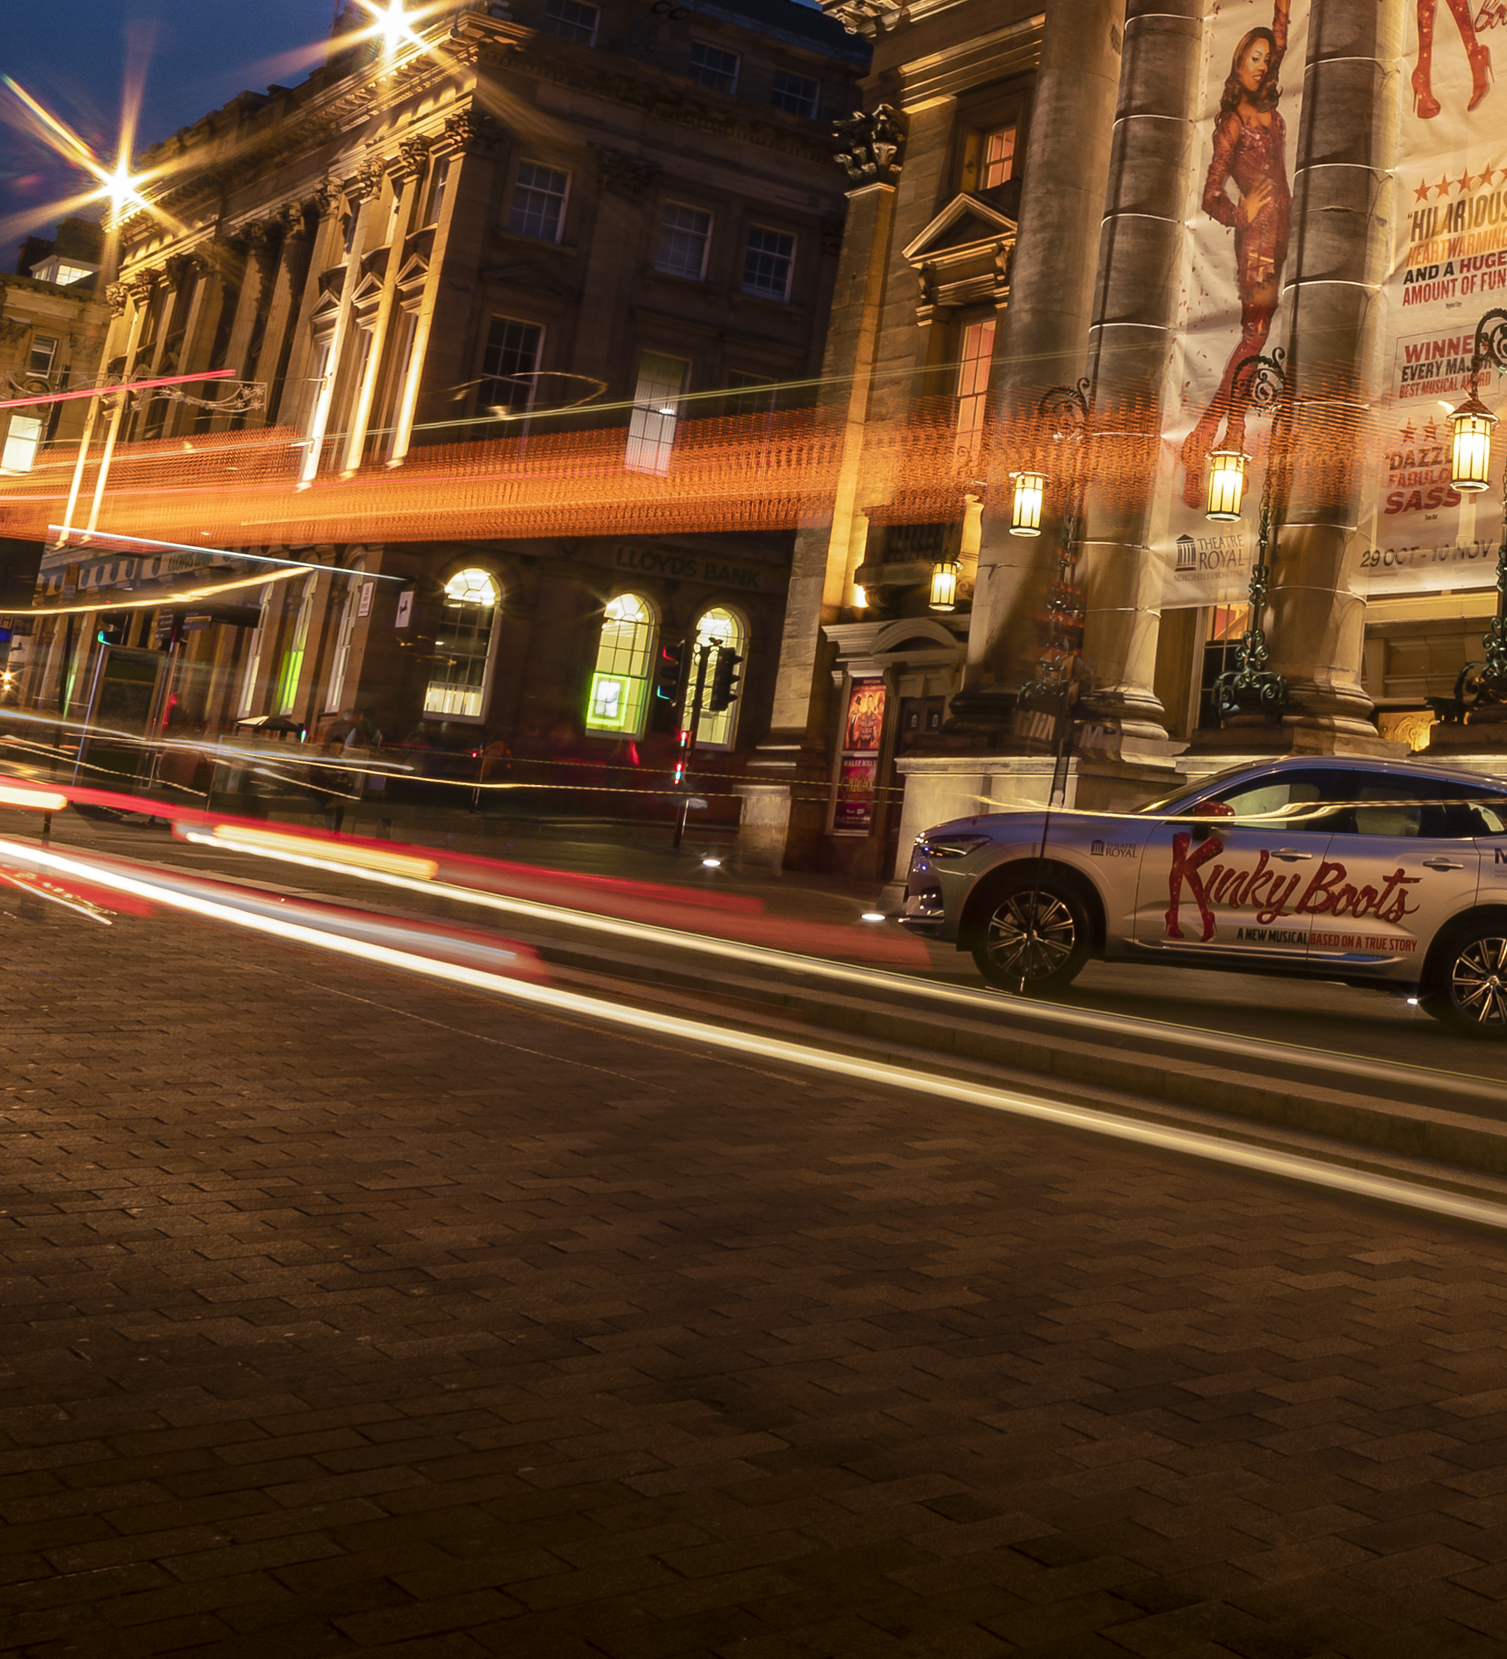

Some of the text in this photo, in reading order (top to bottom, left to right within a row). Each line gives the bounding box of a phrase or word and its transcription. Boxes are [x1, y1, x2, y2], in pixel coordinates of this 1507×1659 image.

[1403, 250, 1507, 285] AND A HUGE
[1402, 278, 1458, 306] AMOUNT
[1461, 274, 1477, 295] OF
[1401, 360, 1443, 382] EVERY
[1399, 382, 1421, 398] BEST
[1422, 377, 1458, 394] MUSICAL
[1197, 534, 1244, 551] THEATRE
[1360, 549, 1380, 567] 29
[1383, 546, 1419, 566] OCT
[1431, 544, 1449, 562] 10
[1452, 539, 1493, 560] NOV
[616, 547, 761, 588] LLOYDS BANK
[1199, 548, 1244, 570] ROYAL
[1106, 848, 1137, 858] ROYAL
[1164, 832, 1423, 941] Kinky Boots
[1237, 928, 1418, 953] A NEW MUSICAL BASED ON A TRUE STORY
